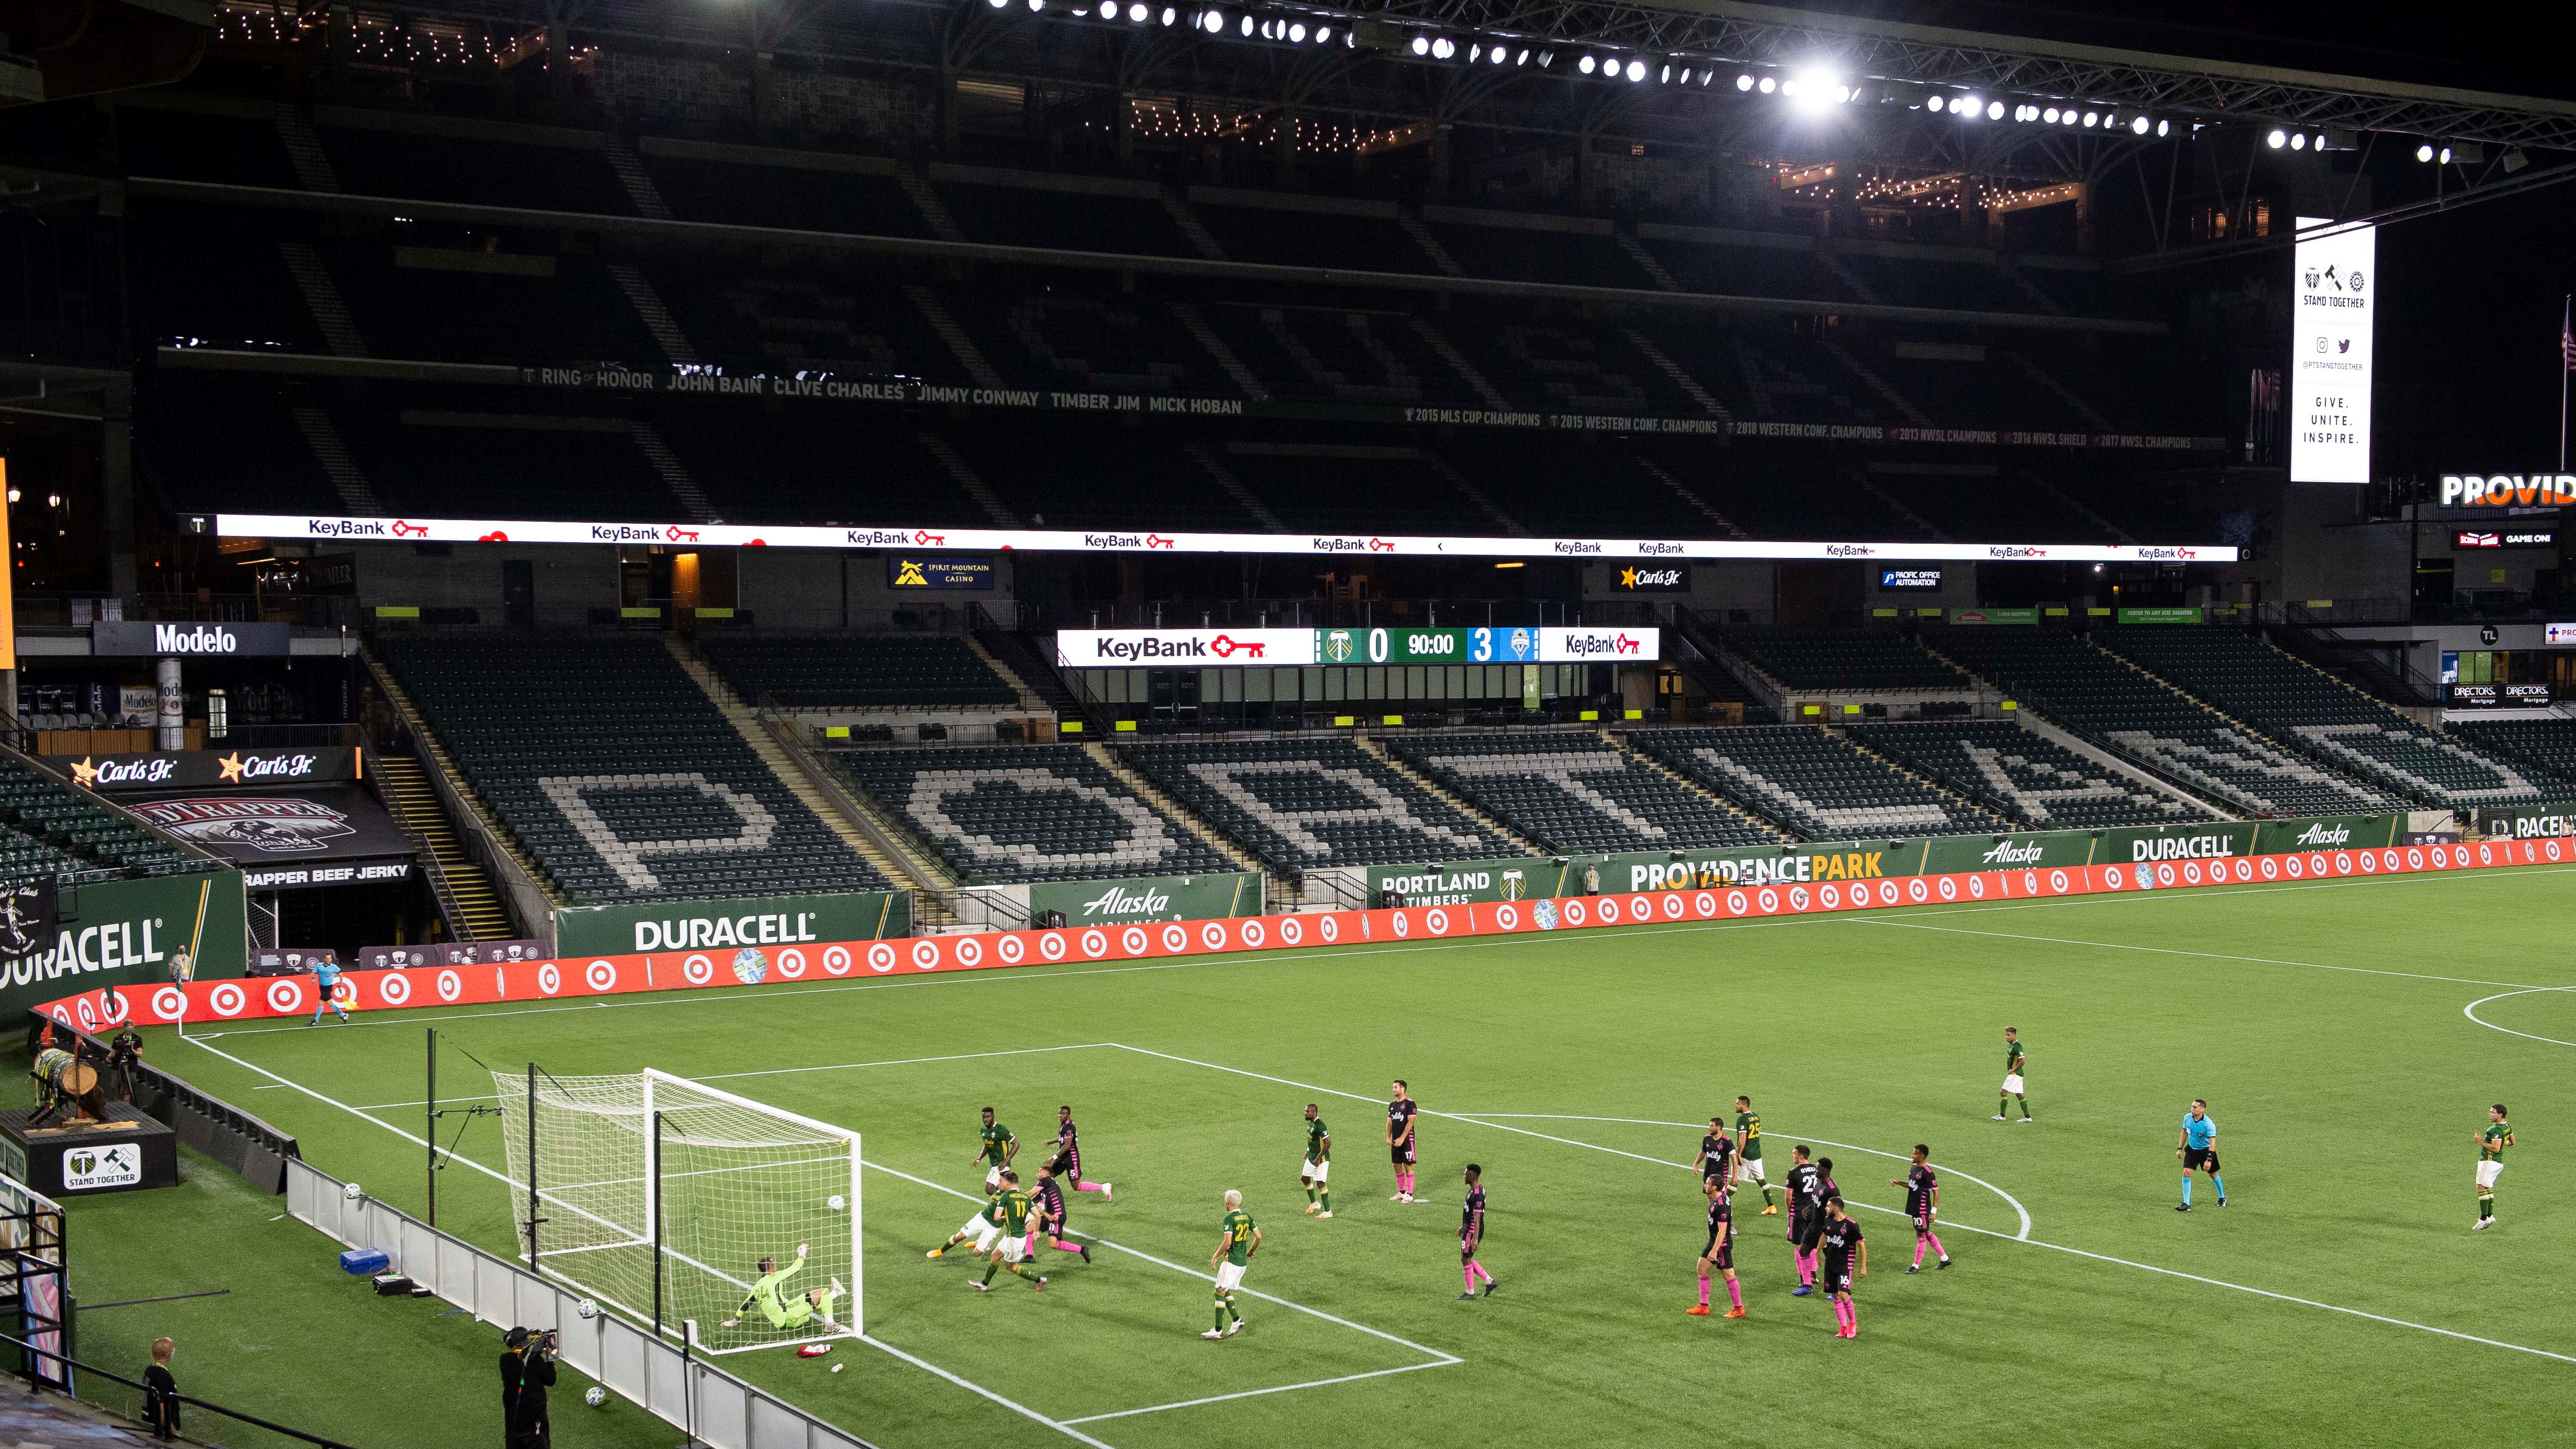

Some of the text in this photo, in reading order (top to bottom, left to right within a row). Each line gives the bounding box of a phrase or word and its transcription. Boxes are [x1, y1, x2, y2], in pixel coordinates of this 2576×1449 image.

[2304, 295, 2364, 308] STAND TOGETHER
[2303, 361, 2363, 370] @PTSTANDTOGETHER
[541, 368, 581, 385] RING
[596, 370, 653, 389] HONOR
[666, 374, 761, 394] JOHN BAIN
[773, 379, 905, 400] CLIVE CHARLES
[916, 385, 1040, 407] JIMMY CONWAY
[1050, 391, 1140, 411] TIMBER JIM
[1149, 396, 1242, 414] MICK HOBAN
[2316, 397, 2348, 408] GIVE.
[1416, 409, 1541, 426] 2015 MLS CUP CHAMPIONS
[1561, 415, 1718, 433] 2015 WESTERN CONF. CHAMPIONS
[2311, 415, 2352, 426] UNITE.
[1736, 422, 1757, 435] 2018
[1758, 423, 1802, 437] WESTERN
[1831, 425, 1883, 440] CHAMPIONS
[1900, 428, 1997, 443] 2013 NWSL CHAMPIONS
[2012, 431, 2087, 446] 2016 NWSL SHIELD
[2304, 432, 2358, 444] INSPIRE.
[2120, 435, 2144, 448] NWSL
[2145, 435, 2191, 449] CHAMPIONS
[309, 520, 385, 536] KeyBank
[592, 526, 660, 542] KeyBank
[848, 531, 909, 546] KeyBank
[1085, 535, 1142, 549] KeyBank
[1314, 538, 1365, 552] KeyBank
[2506, 535, 2533, 543] GAME
[1555, 542, 1601, 555] KeyBank
[1639, 543, 1684, 556] KeyBank
[1827, 545, 1868, 557] KeyBank
[1990, 547, 2029, 559] KeyBank
[2139, 548, 2175, 560] KeyBank
[1635, 569, 1679, 586] Carl's Jr.
[155, 624, 236, 653] Modelo
[2482, 631, 2496, 640] TL
[1098, 627, 1615, 662] KeyBank 0 90:00 3 KeyBank
[126, 694, 156, 708] Modelo
[97, 759, 173, 783] Carl's Jr.
[243, 754, 312, 778] Carl's Jr.
[2296, 823, 2351, 846] Alaska
[1982, 839, 2043, 864] Alaska
[2133, 835, 2233, 862] DURACELL
[312, 868, 354, 882] BEEF
[357, 864, 408, 880] JERKY
[1813, 851, 1883, 881] PARK
[1382, 872, 1490, 894] PORTLAND
[19, 886, 39, 897] Club
[1082, 886, 1170, 916] Alaska
[1406, 894, 1468, 908] TIMBERS
[635, 913, 816, 951] DURACELL
[1748, 1122, 1761, 1139] 25
[1405, 1151, 1413, 1160] 17
[70, 1174, 135, 1186] STAND TOGETHER
[1015, 1200, 1026, 1218] 11
[1913, 1217, 1923, 1226] 10
[1235, 1222, 1250, 1242] 22
[1840, 1275, 1850, 1285] 16
